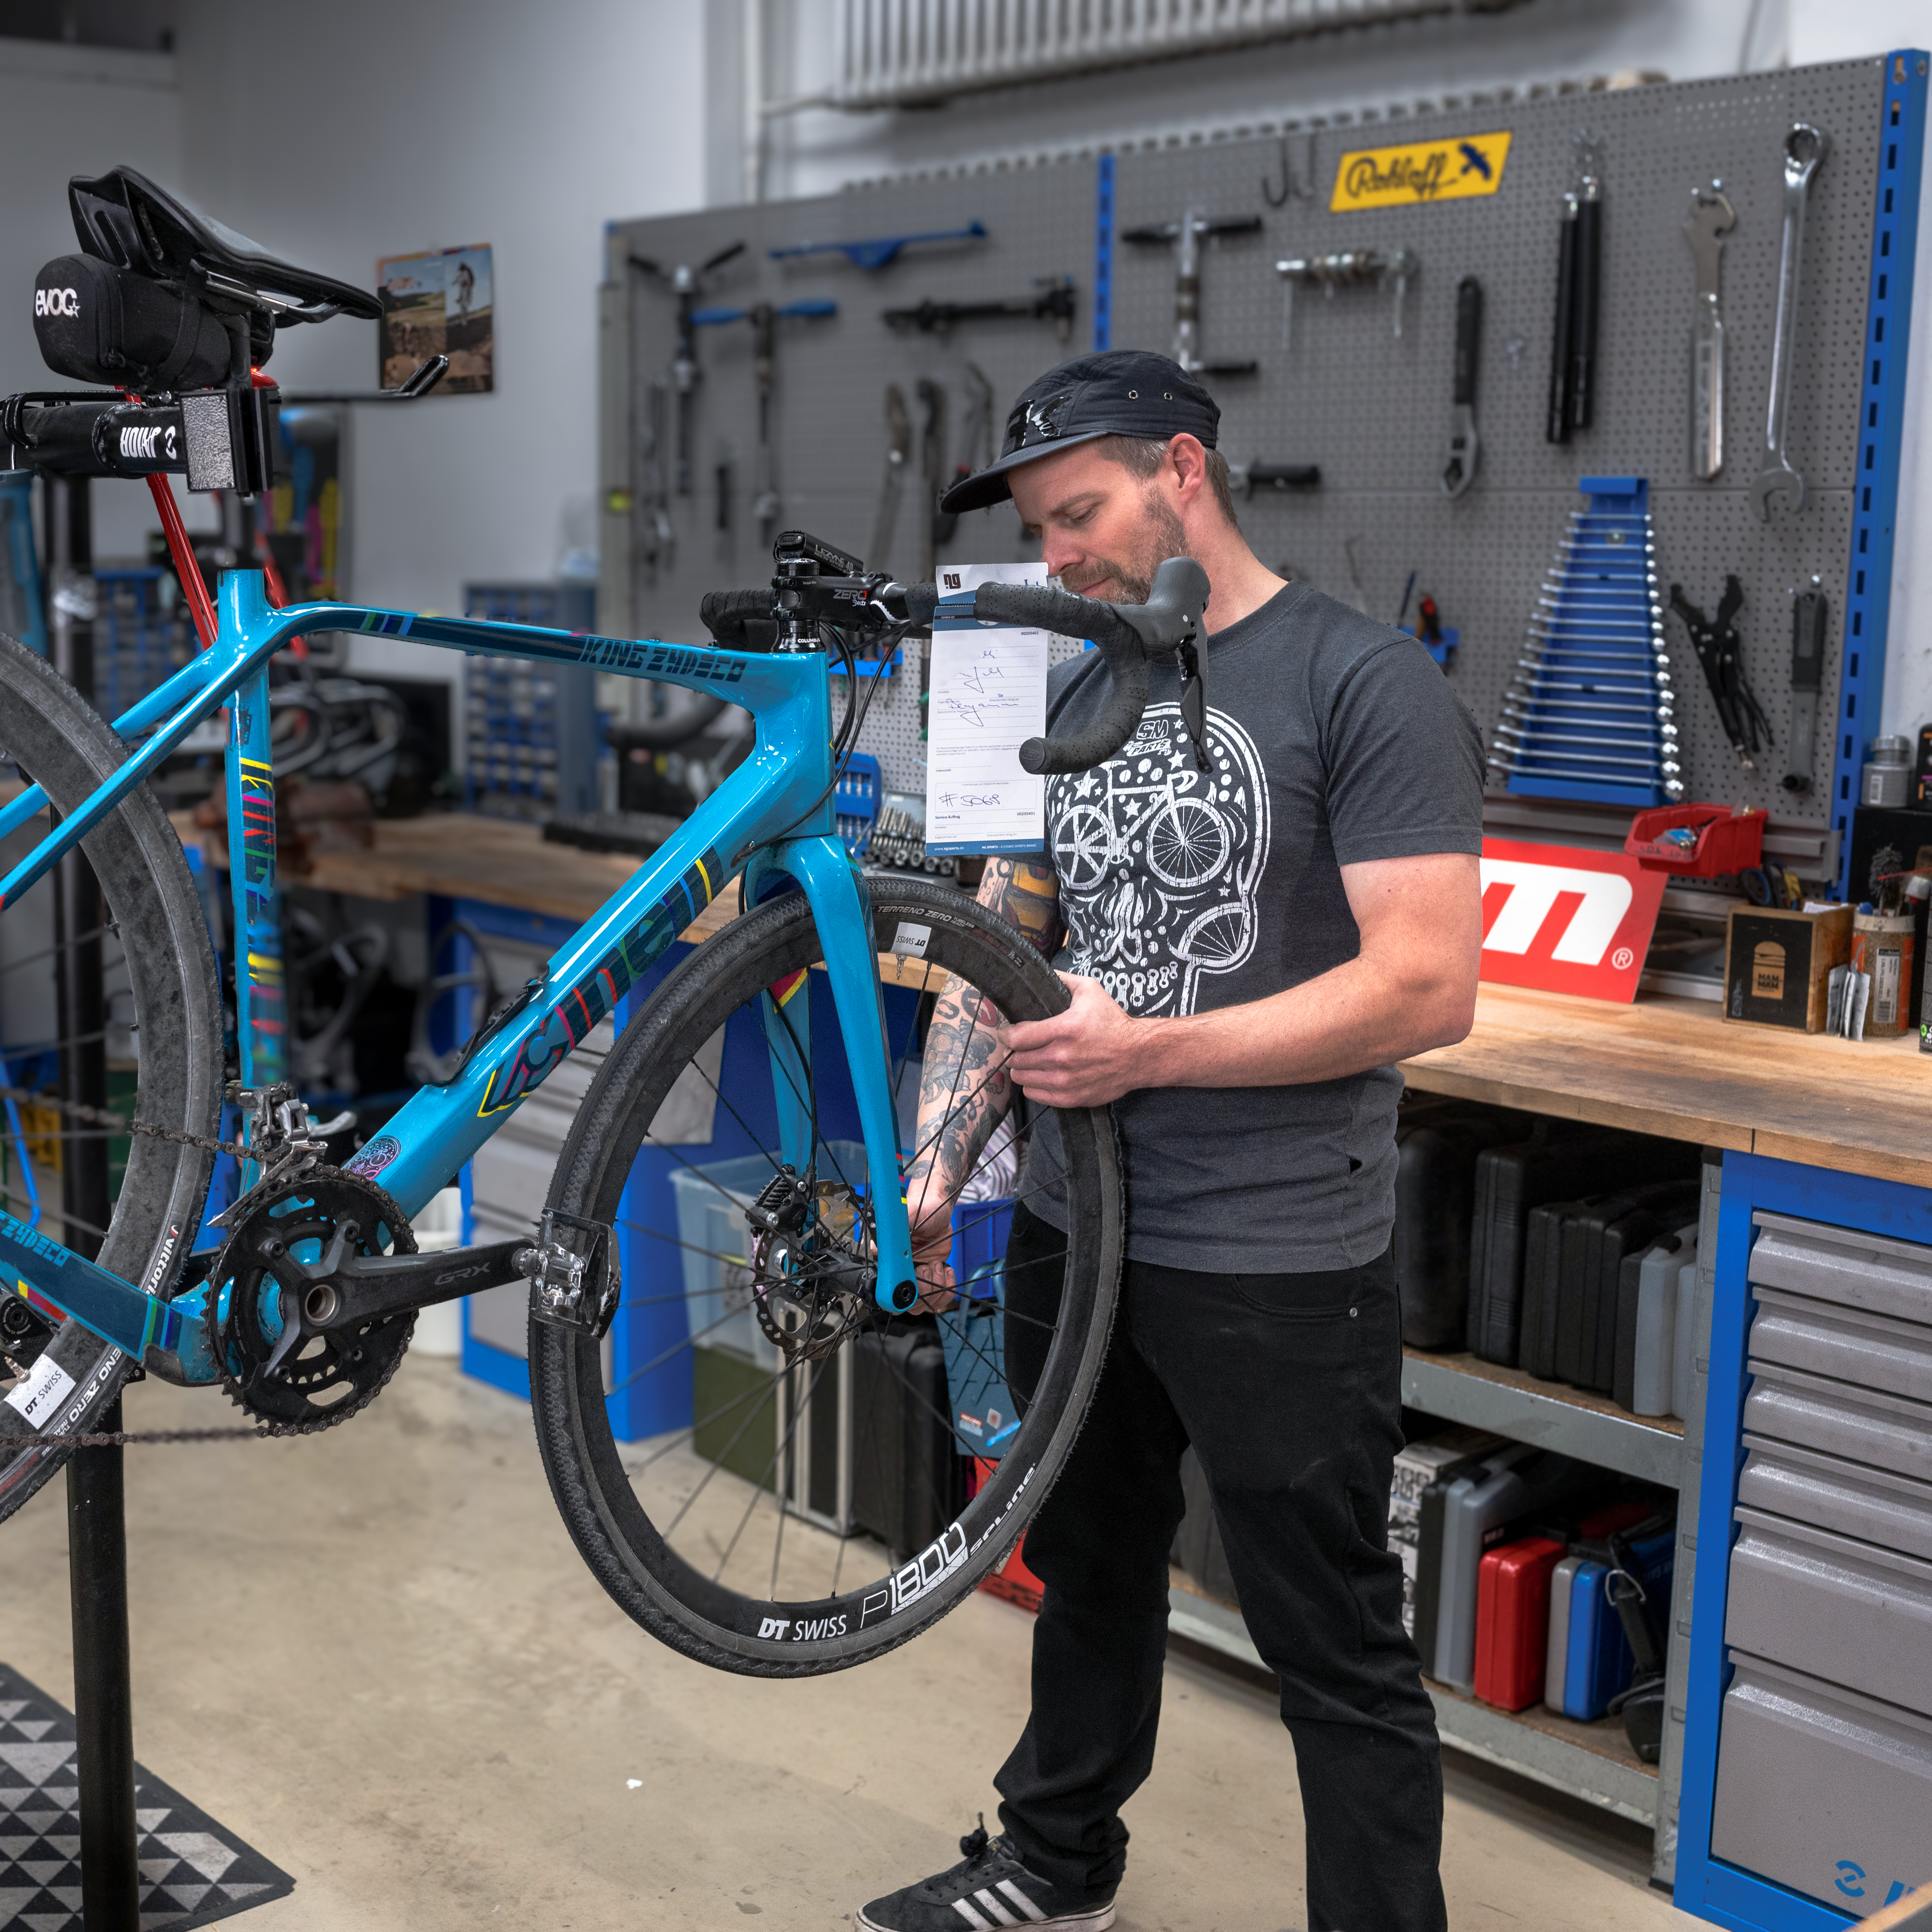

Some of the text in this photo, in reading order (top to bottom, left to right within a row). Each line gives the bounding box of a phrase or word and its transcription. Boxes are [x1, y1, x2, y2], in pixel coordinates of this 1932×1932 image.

[1345, 155, 1456, 201] Rohloff
[815, 544, 845, 565] LEZYNE
[579, 638, 649, 669] KING
[1132, 740, 1168, 755] PARTS
[878, 906, 953, 922] TERRENO ZERO
[896, 935, 926, 947] DT SWISS
[434, 1262, 490, 1286] GRX
[24, 1370, 62, 1416] DT SWISS
[69, 1379, 100, 1423] ZERO
[758, 1614, 847, 1642] DT SWISS
